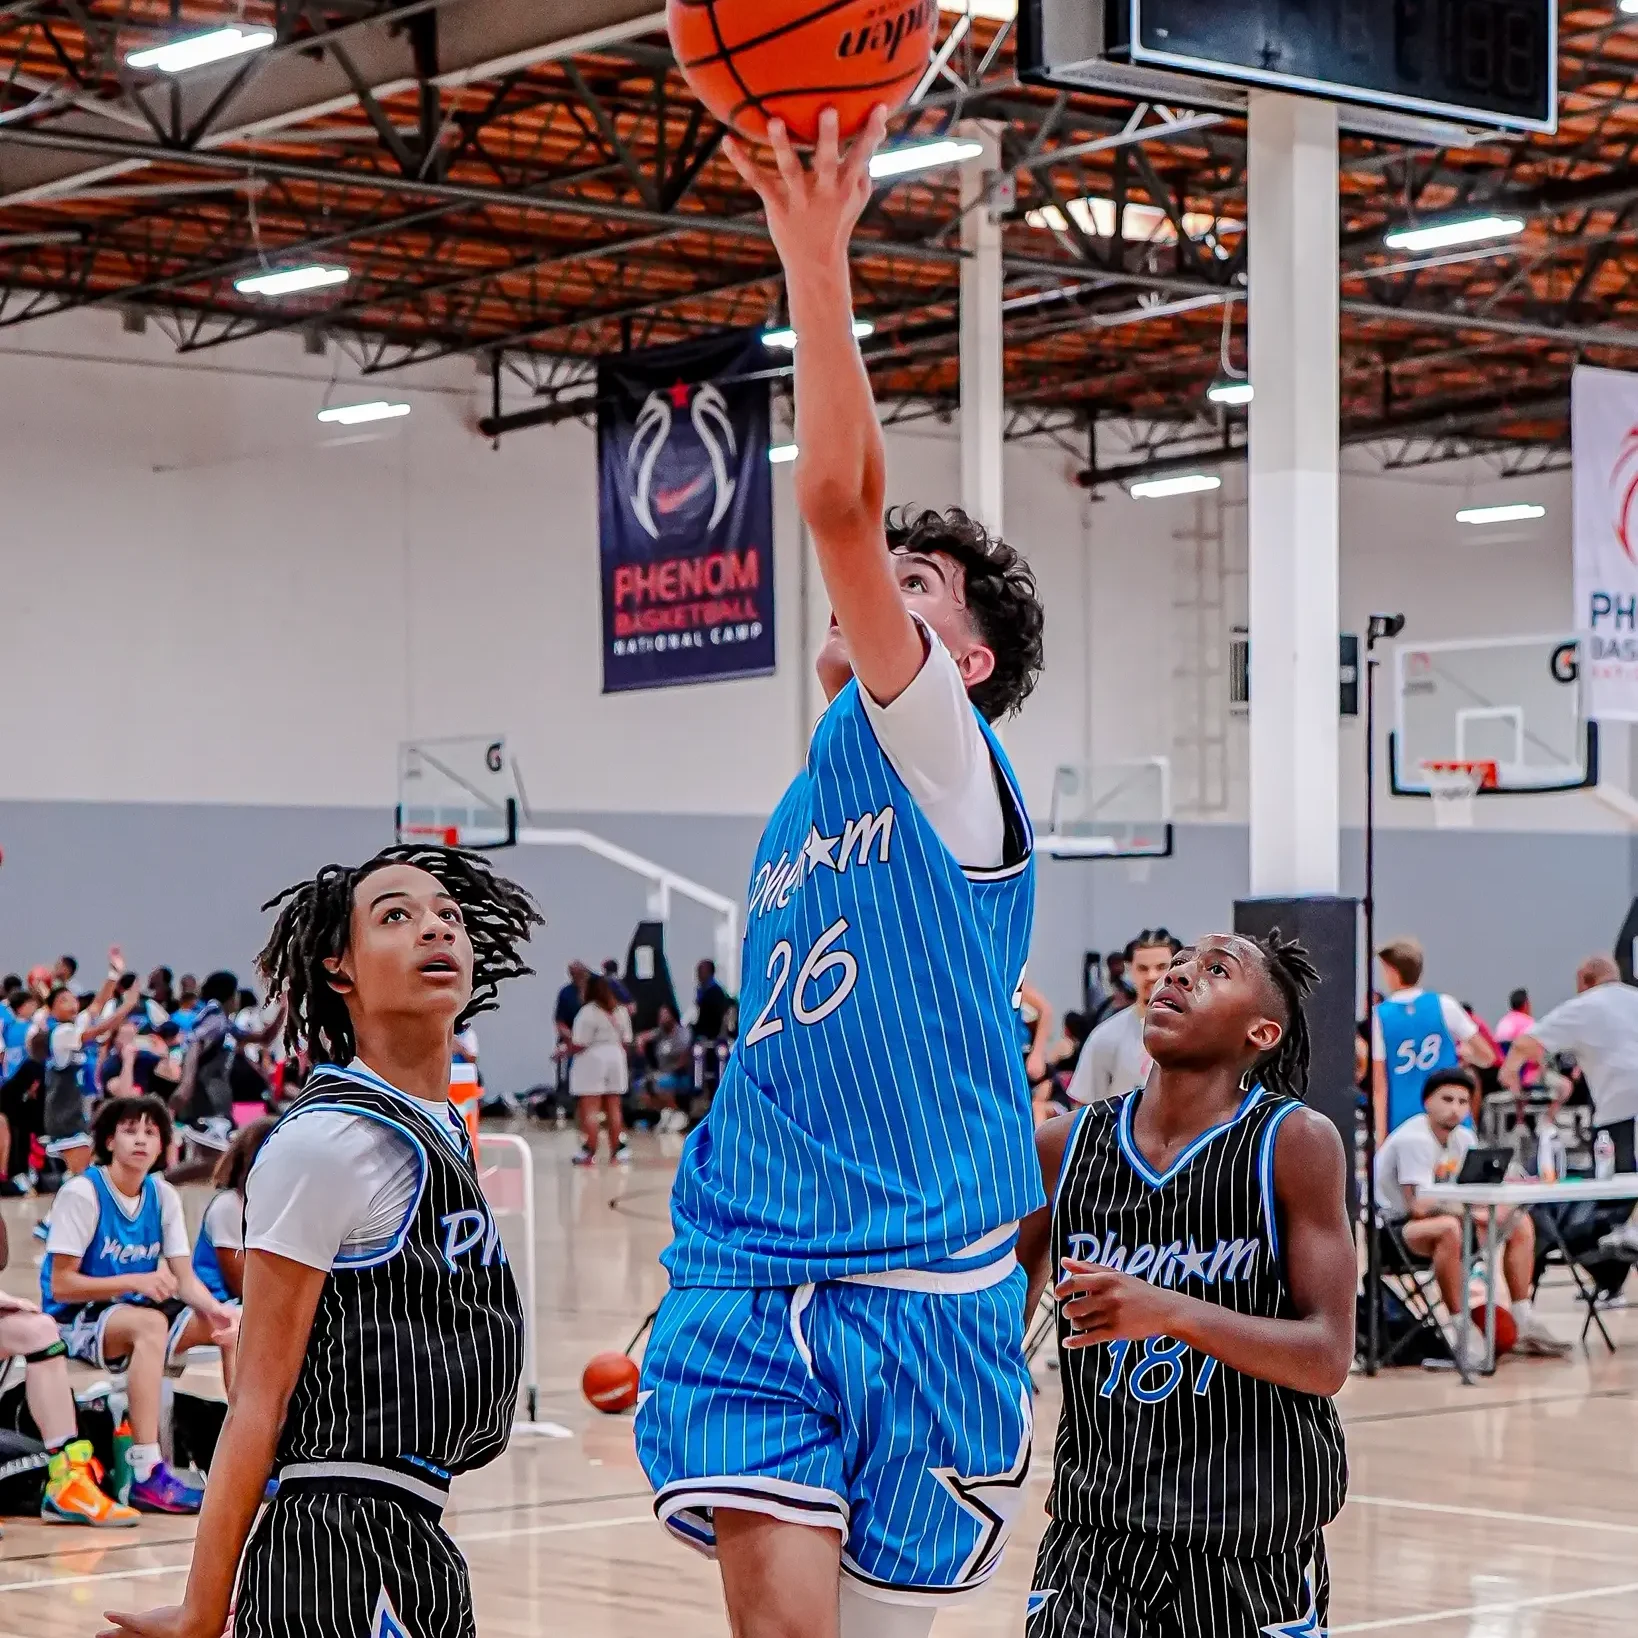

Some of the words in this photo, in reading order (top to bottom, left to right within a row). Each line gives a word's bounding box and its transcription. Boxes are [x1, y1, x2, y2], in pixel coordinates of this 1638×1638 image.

[615, 549, 759, 606] PHENOM
[745, 916, 858, 1047] 26
[1394, 1034, 1442, 1075] 58
